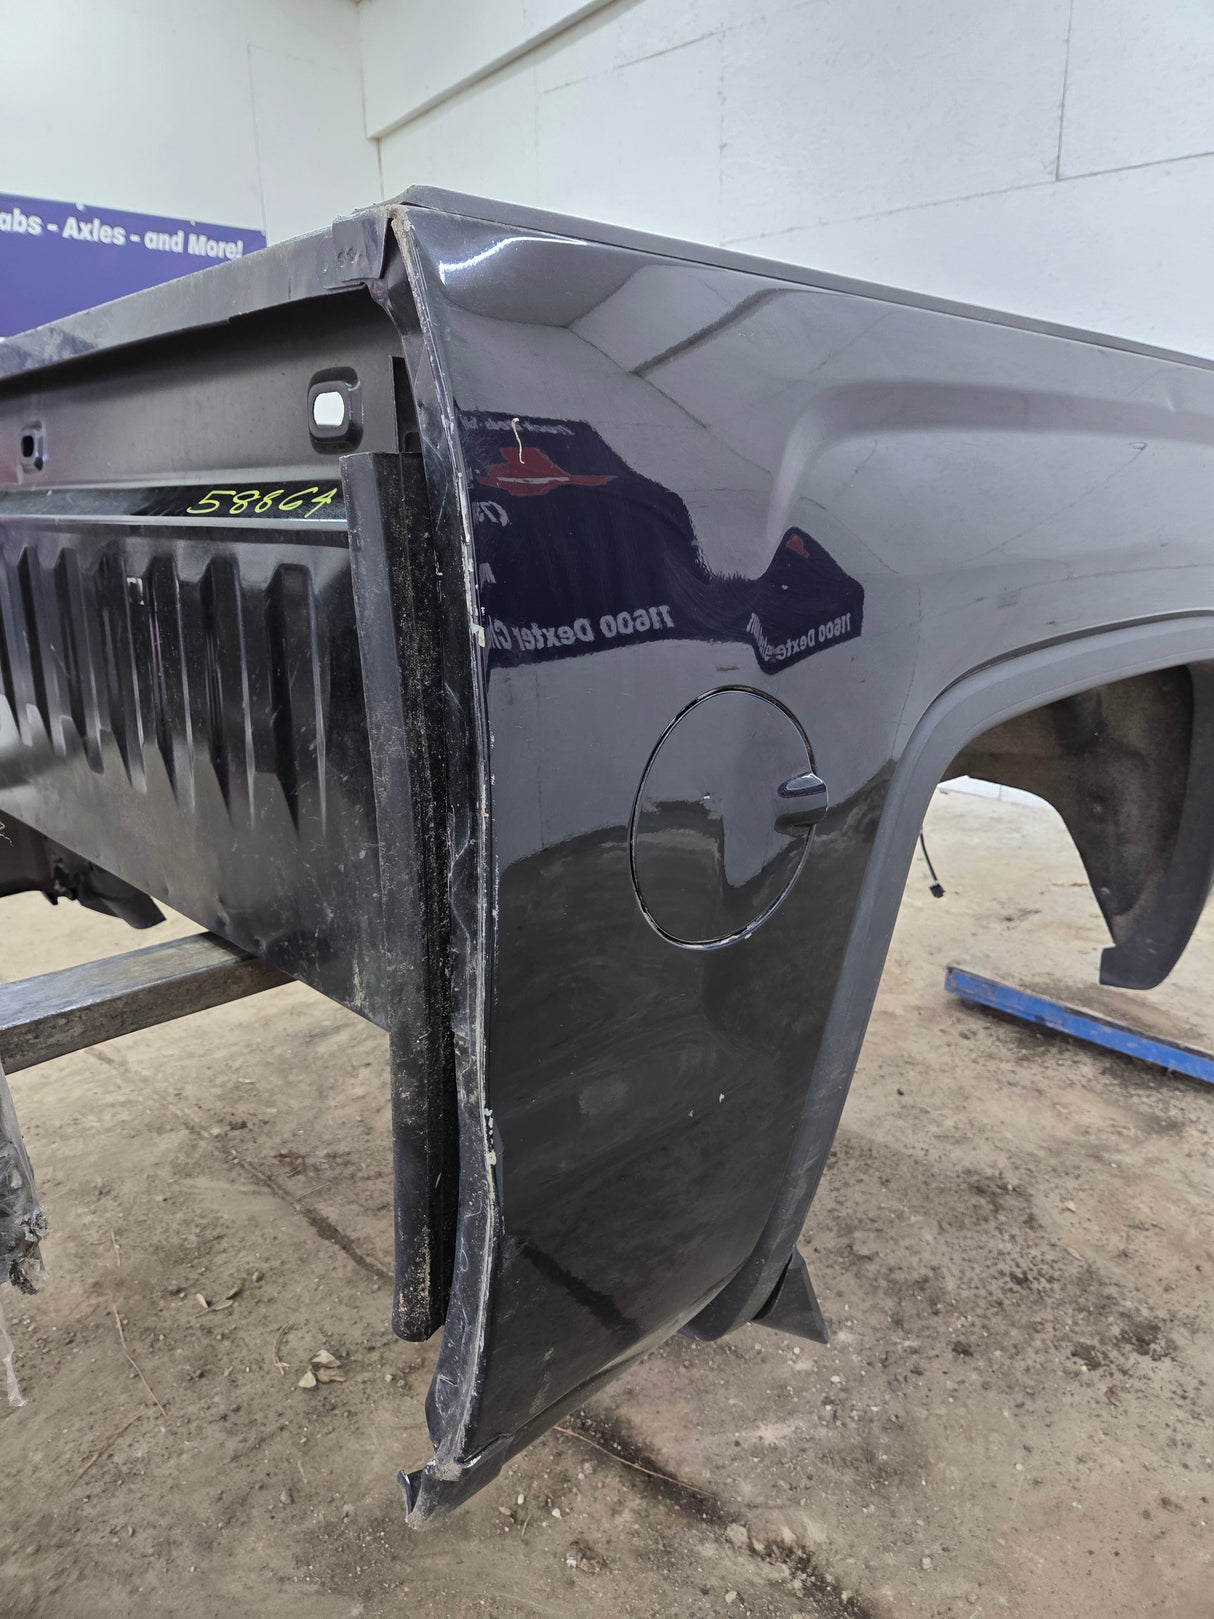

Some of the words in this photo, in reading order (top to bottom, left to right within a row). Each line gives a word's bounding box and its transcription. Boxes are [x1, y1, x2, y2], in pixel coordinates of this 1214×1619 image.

[62, 216, 127, 246] Axles
[144, 230, 184, 253] and
[188, 234, 244, 260] More!
